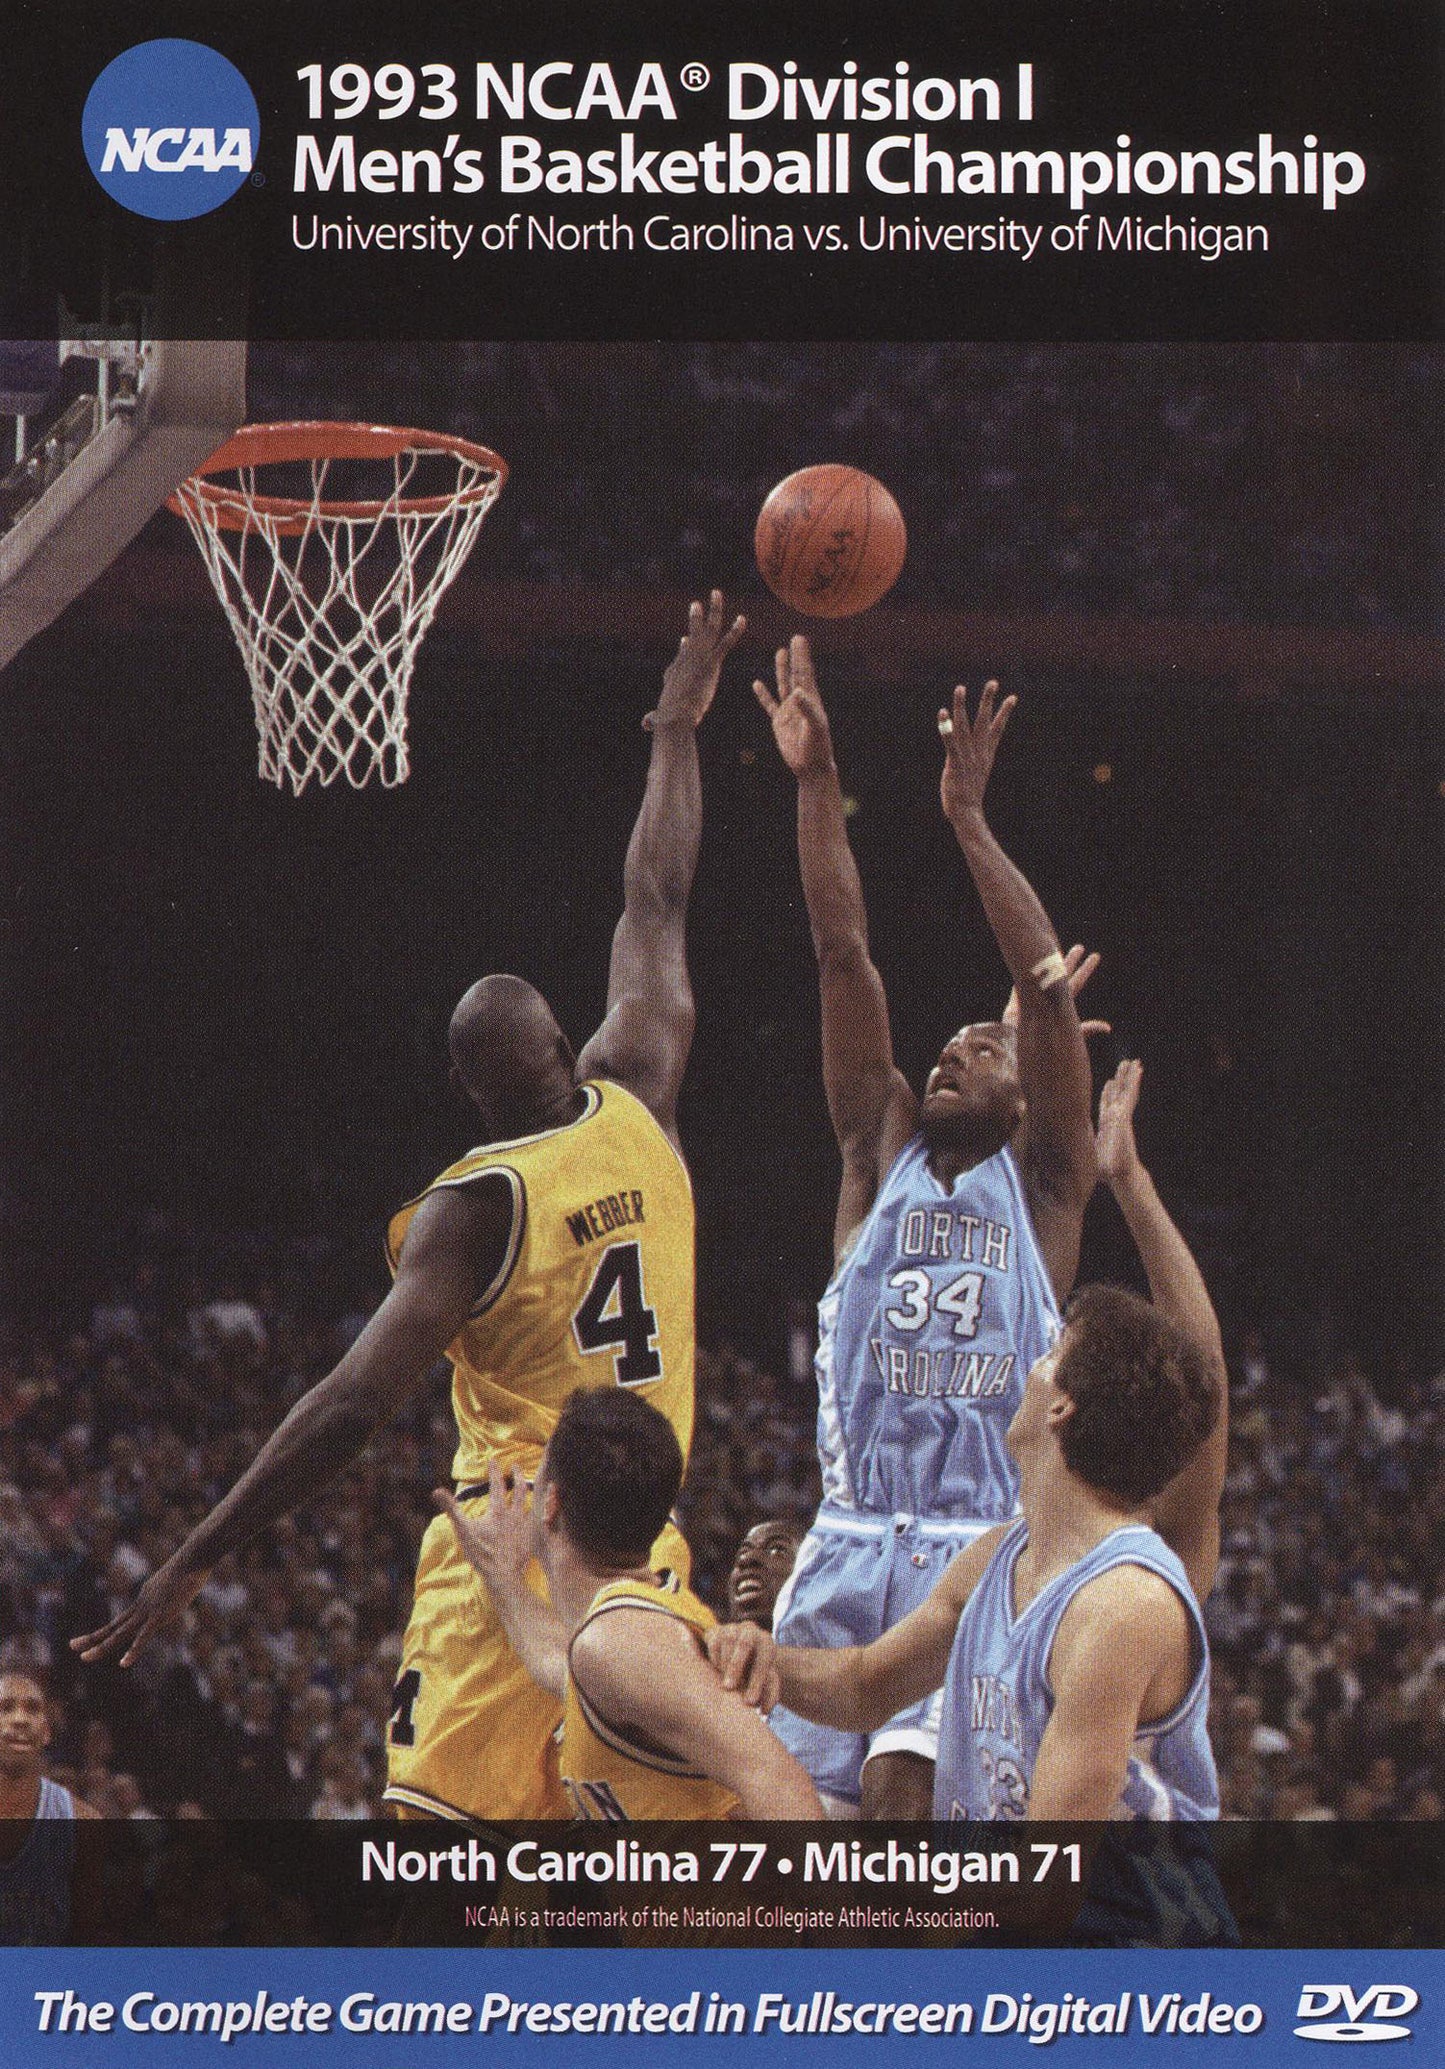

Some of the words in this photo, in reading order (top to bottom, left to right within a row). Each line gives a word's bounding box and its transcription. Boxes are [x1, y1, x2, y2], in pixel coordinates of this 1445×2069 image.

[297, 63, 457, 120] 1993
[729, 61, 1000, 121] Division
[1018, 63, 1033, 121] I
[101, 128, 252, 172] NCAA
[501, 133, 849, 194] Basketball
[866, 133, 1366, 210] Championship
[292, 214, 474, 260] University
[482, 214, 521, 251] of
[528, 214, 634, 251] North
[644, 214, 794, 251] Carolina
[803, 224, 849, 251] vs.
[859, 215, 1043, 261] University
[1051, 214, 1091, 251] of
[1097, 214, 1269, 261] Michigan
[565, 1189, 645, 1247] WEBBER
[571, 1239, 665, 1388] 4
[885, 1268, 987, 1338] 34
[362, 1839, 496, 1882] North
[507, 1839, 699, 1882] Carolina
[710, 1843, 767, 1882] 77
[803, 1840, 1019, 1894] Michigan
[1030, 1843, 1080, 1882] 71
[465, 1905, 510, 1928] NCAA
[514, 1906, 527, 1928] is
[530, 1911, 540, 1928] a
[543, 1905, 628, 1928] trademark
[632, 1905, 649, 1928] of
[652, 1906, 679, 1928] the
[683, 1905, 751, 1928] National
[755, 1905, 834, 1933] Collegiate
[837, 1905, 900, 1928] Athletic
[904, 1906, 999, 1928] Association.
[34, 1989, 115, 2032] The
[122, 1990, 332, 2043] Complete
[339, 1992, 473, 2033] Game
[478, 1991, 702, 2033] Presented
[703, 1991, 746, 2033] in
[753, 1991, 973, 2033] Fullscreen
[980, 1992, 1131, 2045] Digital
[1138, 1992, 1264, 2034] Video
[1296, 1984, 1419, 2020] DVD
